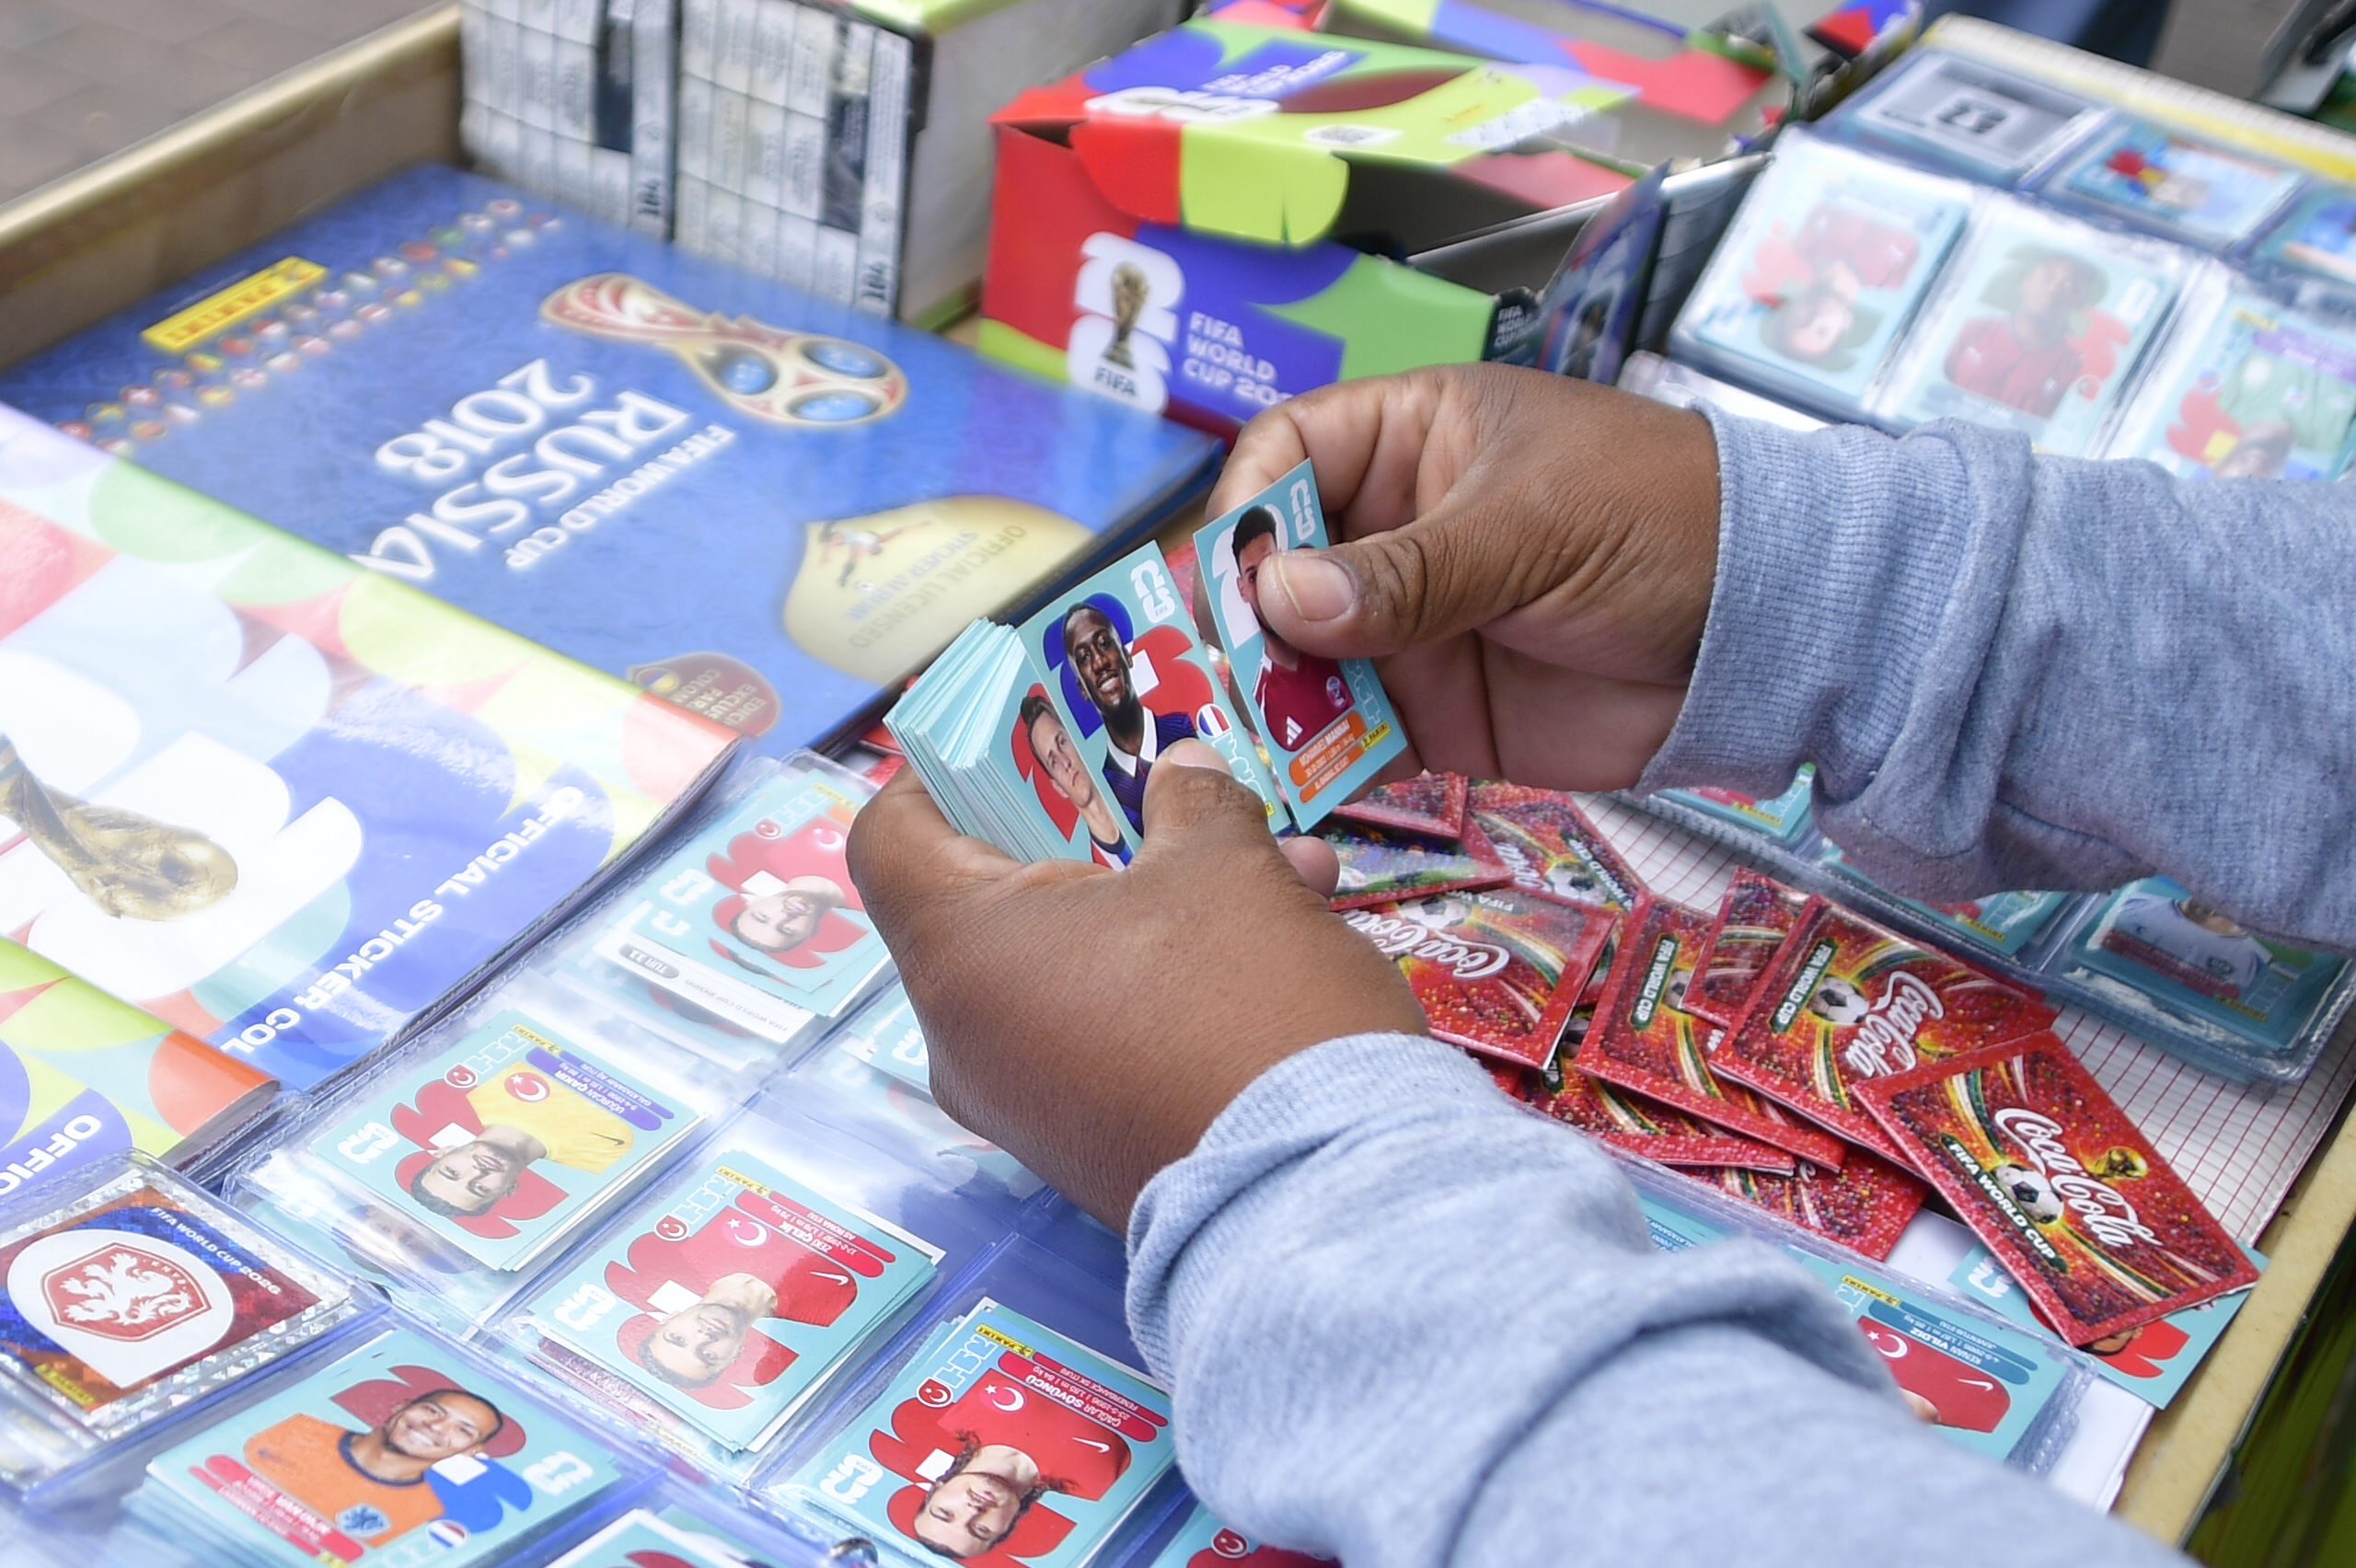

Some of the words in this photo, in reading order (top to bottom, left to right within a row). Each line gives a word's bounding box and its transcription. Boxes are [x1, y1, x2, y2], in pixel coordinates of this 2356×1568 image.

[1190, 311, 1242, 349] FIFA
[1185, 333, 1278, 382] WORLD
[1092, 365, 1137, 397] FIFA
[1182, 357, 1233, 387] CUP
[1232, 375, 1294, 407] 20
[375, 358, 595, 478] 2018
[658, 422, 736, 464] FIFA
[348, 390, 691, 578] RUSSIA
[560, 457, 677, 530] WORLD
[505, 525, 568, 568] CUP
[910, 529, 980, 578] STICKER
[938, 525, 1027, 582] OFFICIAL
[848, 579, 947, 648] LICENSED
[702, 683, 758, 720] EXCLUS
[434, 785, 584, 895] OFFICIAL
[1568, 838, 1593, 860] CUP
[1588, 859, 1628, 903] WORLD
[1477, 894, 1515, 913] FIFA
[294, 899, 445, 1010] STICKER
[643, 957, 668, 974] TUR
[1662, 940, 1675, 961] FIFA
[1815, 943, 1833, 967] FIFA
[1646, 959, 1671, 998] WORLD
[1789, 965, 1820, 1008] WORLD
[1634, 997, 1655, 1021] CUP
[1776, 1002, 1798, 1025] CUP
[514, 1025, 546, 1045] PANINI
[553, 1068, 589, 1091] ÇAKIR
[718, 1168, 753, 1187] PANINI
[1948, 1141, 1979, 1176] FIFA
[1978, 1173, 2027, 1228] WORLD
[2025, 1223, 2056, 1261] CUP
[778, 1218, 814, 1243] ÇELİK
[821, 1219, 846, 1236] ROMA
[1648, 1219, 1696, 1250] ALATASARAY
[150, 1206, 178, 1227] FIFA
[176, 1222, 219, 1253] WORLD
[214, 1249, 243, 1270] CUP
[238, 1264, 282, 1297] 2026
[1843, 1277, 1881, 1297] PANINI
[977, 1327, 1015, 1348] PANINI
[1948, 1344, 1982, 1365] KENAN
[1955, 1327, 1996, 1351] JUVENTUS
[1081, 1401, 1123, 1428] ÇAĞLAR
